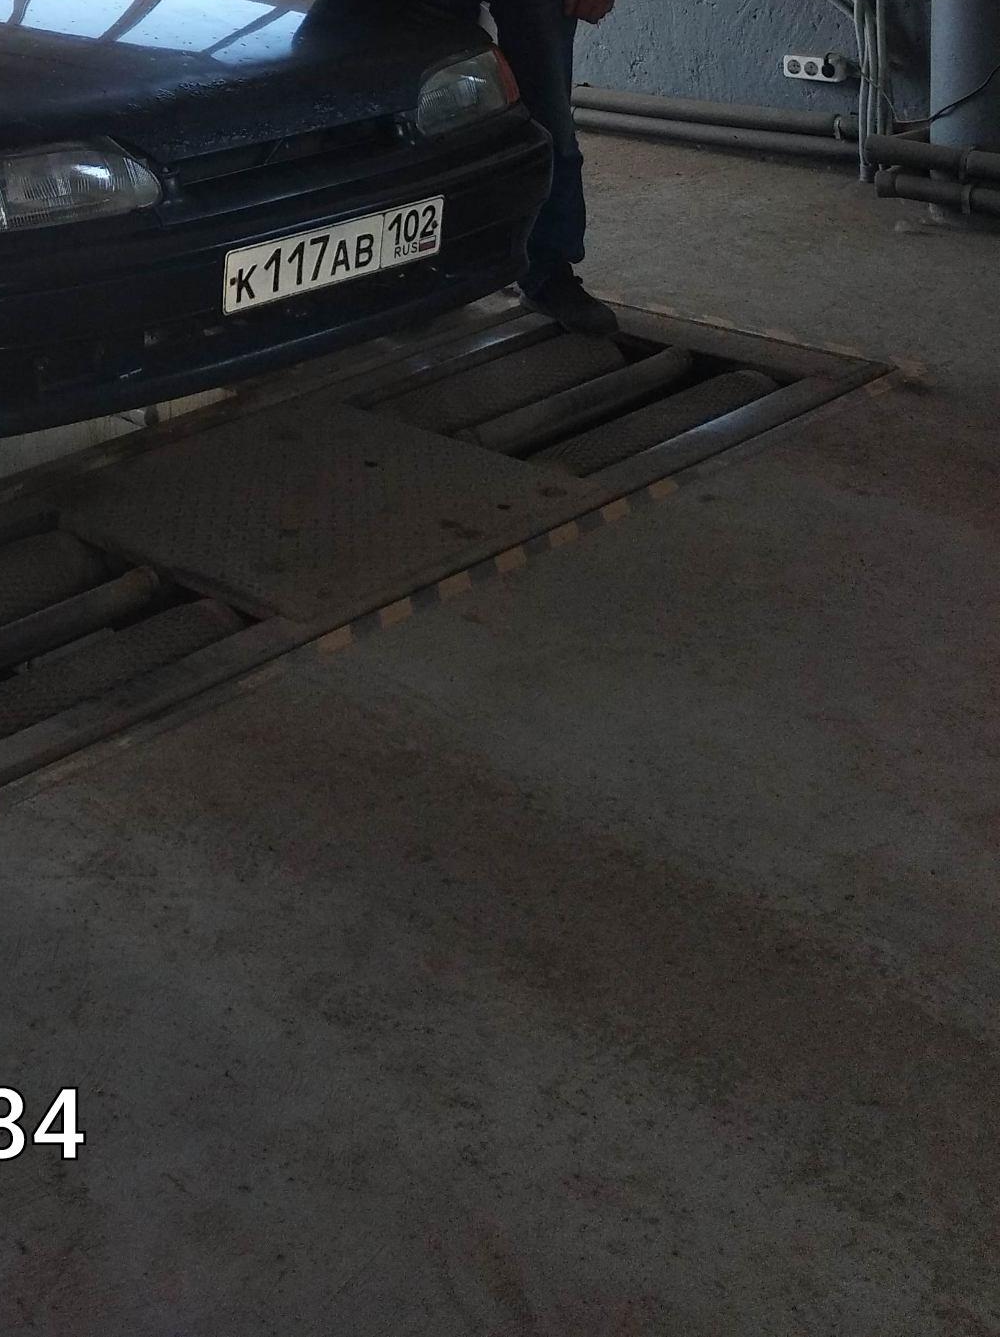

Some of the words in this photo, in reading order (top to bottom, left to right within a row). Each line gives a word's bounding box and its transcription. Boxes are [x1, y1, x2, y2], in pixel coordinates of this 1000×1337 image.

[235, 233, 374, 304] К117АВ
[387, 204, 436, 246] 102
[394, 243, 418, 259] RUS
